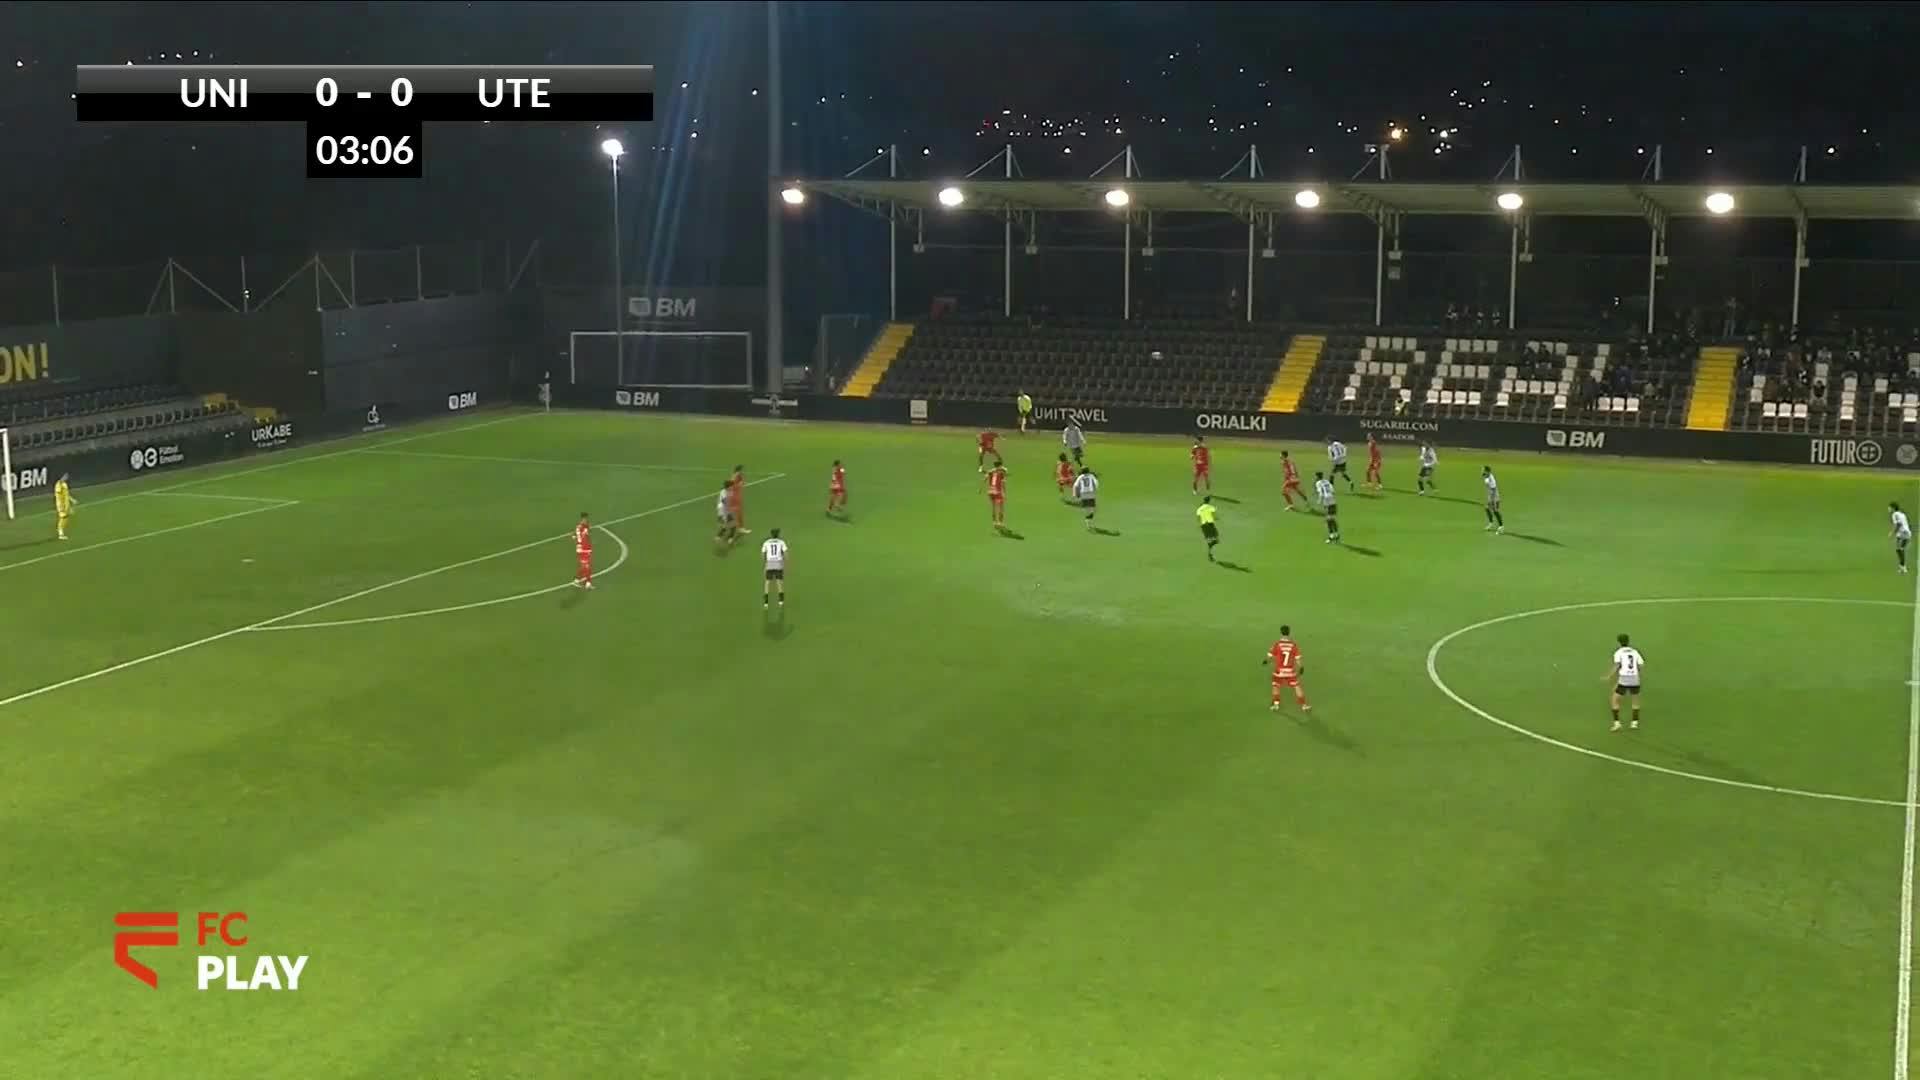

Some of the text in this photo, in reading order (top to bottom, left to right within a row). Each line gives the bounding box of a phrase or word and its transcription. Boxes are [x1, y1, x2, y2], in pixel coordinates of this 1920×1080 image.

[655, 298, 696, 317] BM
[460, 391, 477, 408] BM
[633, 391, 660, 407] BM
[1034, 407, 1109, 427] UNITRAVEL
[1196, 413, 1267, 432] ORIALKI
[251, 423, 293, 443] URKABE
[1568, 431, 1605, 448] BM
[20, 466, 48, 489] BM
[770, 543, 778, 557] 11
[1281, 651, 1291, 667] 7
